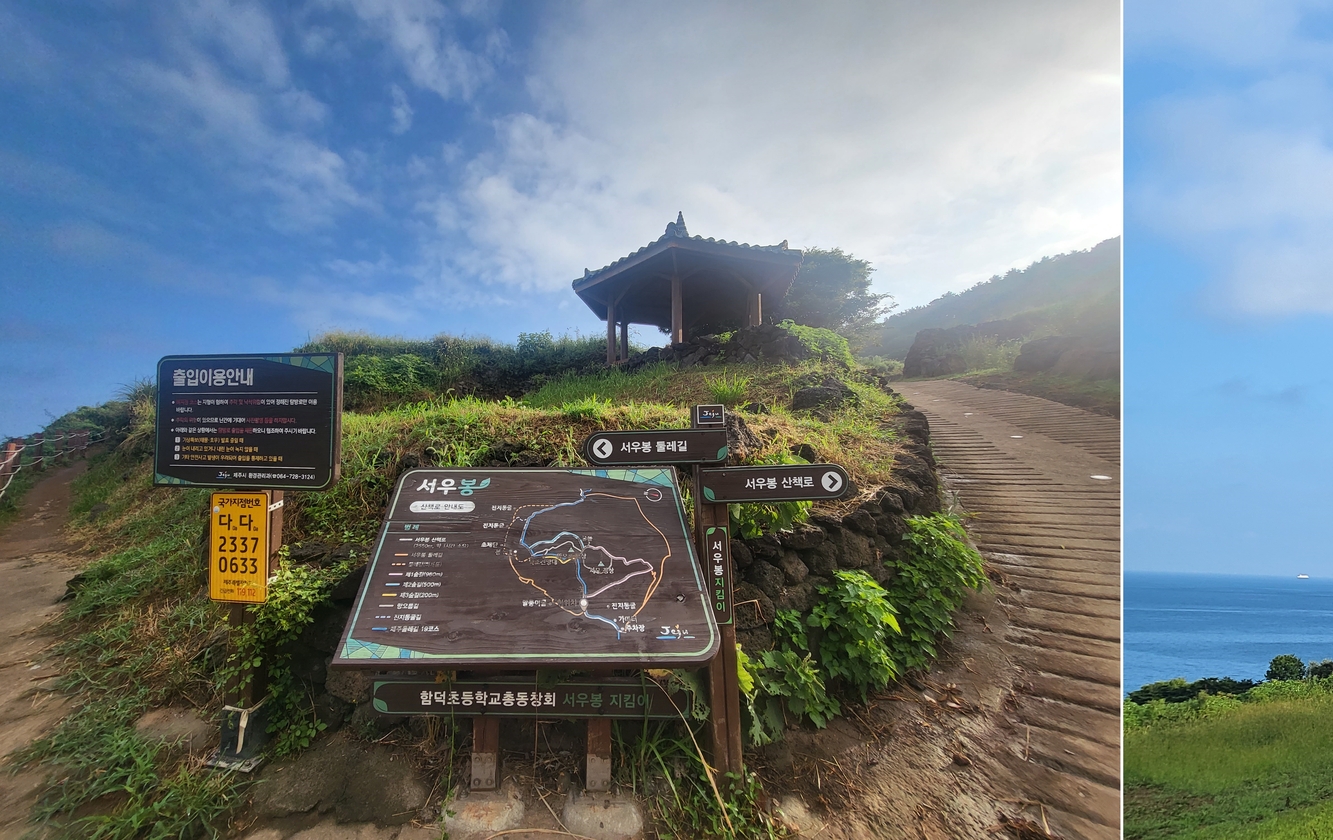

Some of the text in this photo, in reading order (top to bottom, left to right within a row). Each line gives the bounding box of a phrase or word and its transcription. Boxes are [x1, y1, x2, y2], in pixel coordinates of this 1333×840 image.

[173, 368, 254, 386] 출입이용안내
[620, 440, 688, 453] 서우봉 둘레길
[416, 478, 477, 496] 서우봉
[745, 476, 814, 490] 서우봉 산책로
[218, 498, 261, 508] 국가지점번호
[218, 514, 232, 530] 다
[240, 514, 253, 531] 다
[218, 536, 259, 553] 2337
[218, 557, 257, 574] 0633
[712, 541, 726, 612] 서우봉 지킴이
[660, 624, 688, 639] Jeju
[420, 690, 649, 708] 함덕초등학교총동창회 서우봉 지킴이
